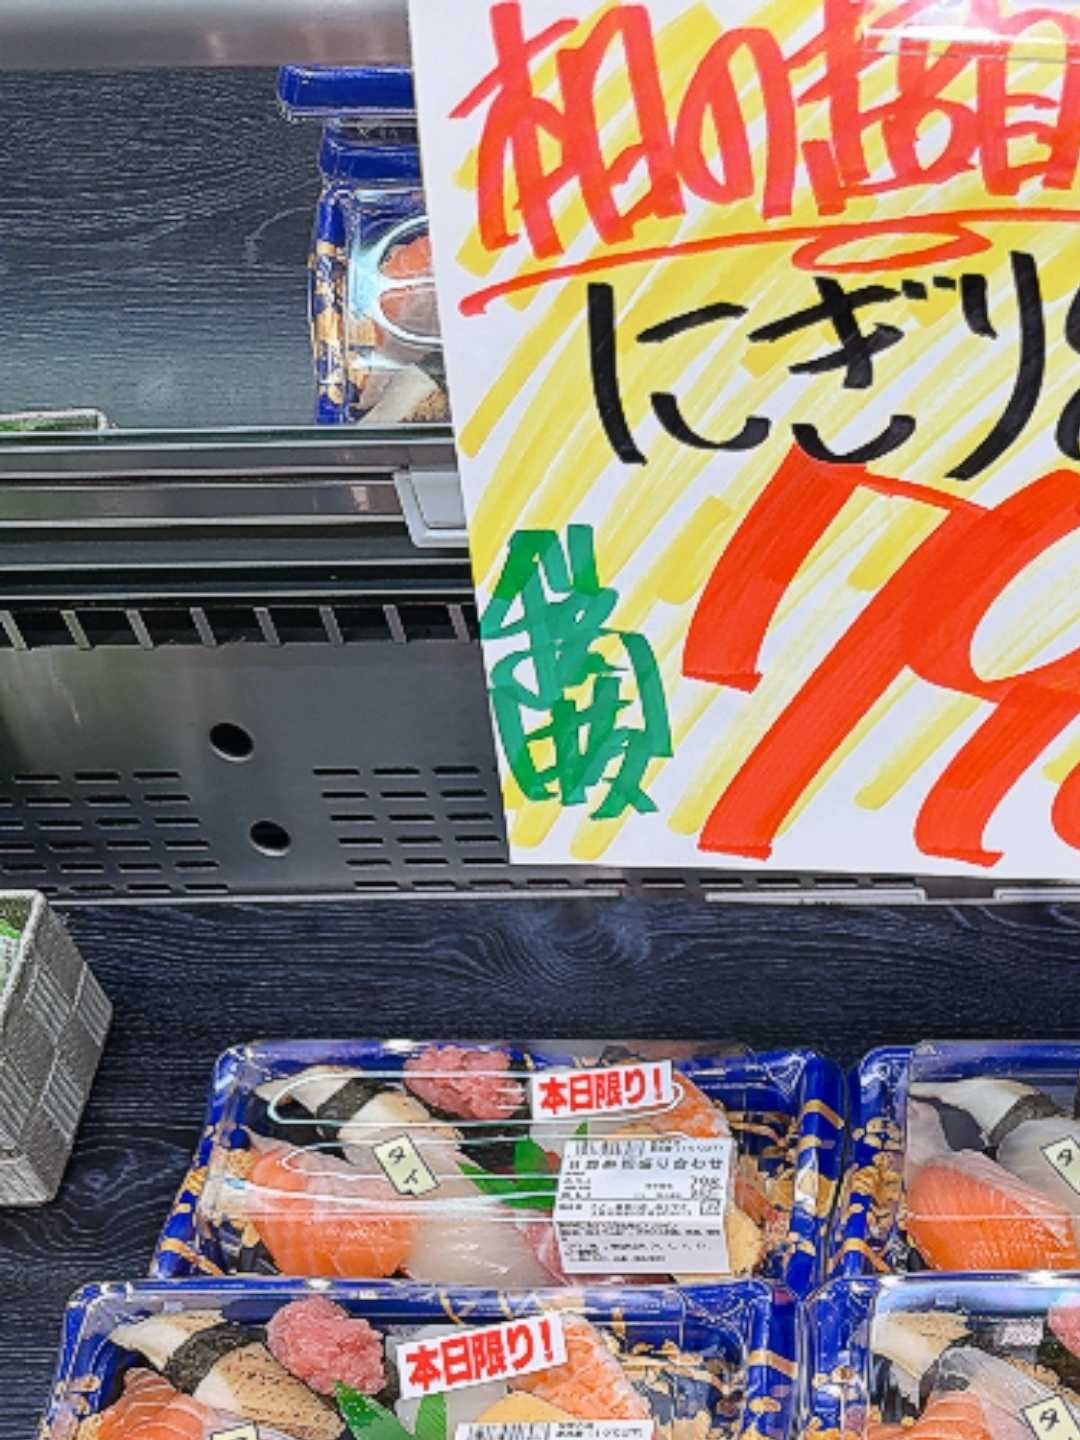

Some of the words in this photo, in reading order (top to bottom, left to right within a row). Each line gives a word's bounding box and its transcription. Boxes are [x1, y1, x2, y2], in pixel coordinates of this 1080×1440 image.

[538, 1067, 664, 1114] 本日限り!
[405, 1322, 556, 1391] 本日限り!
